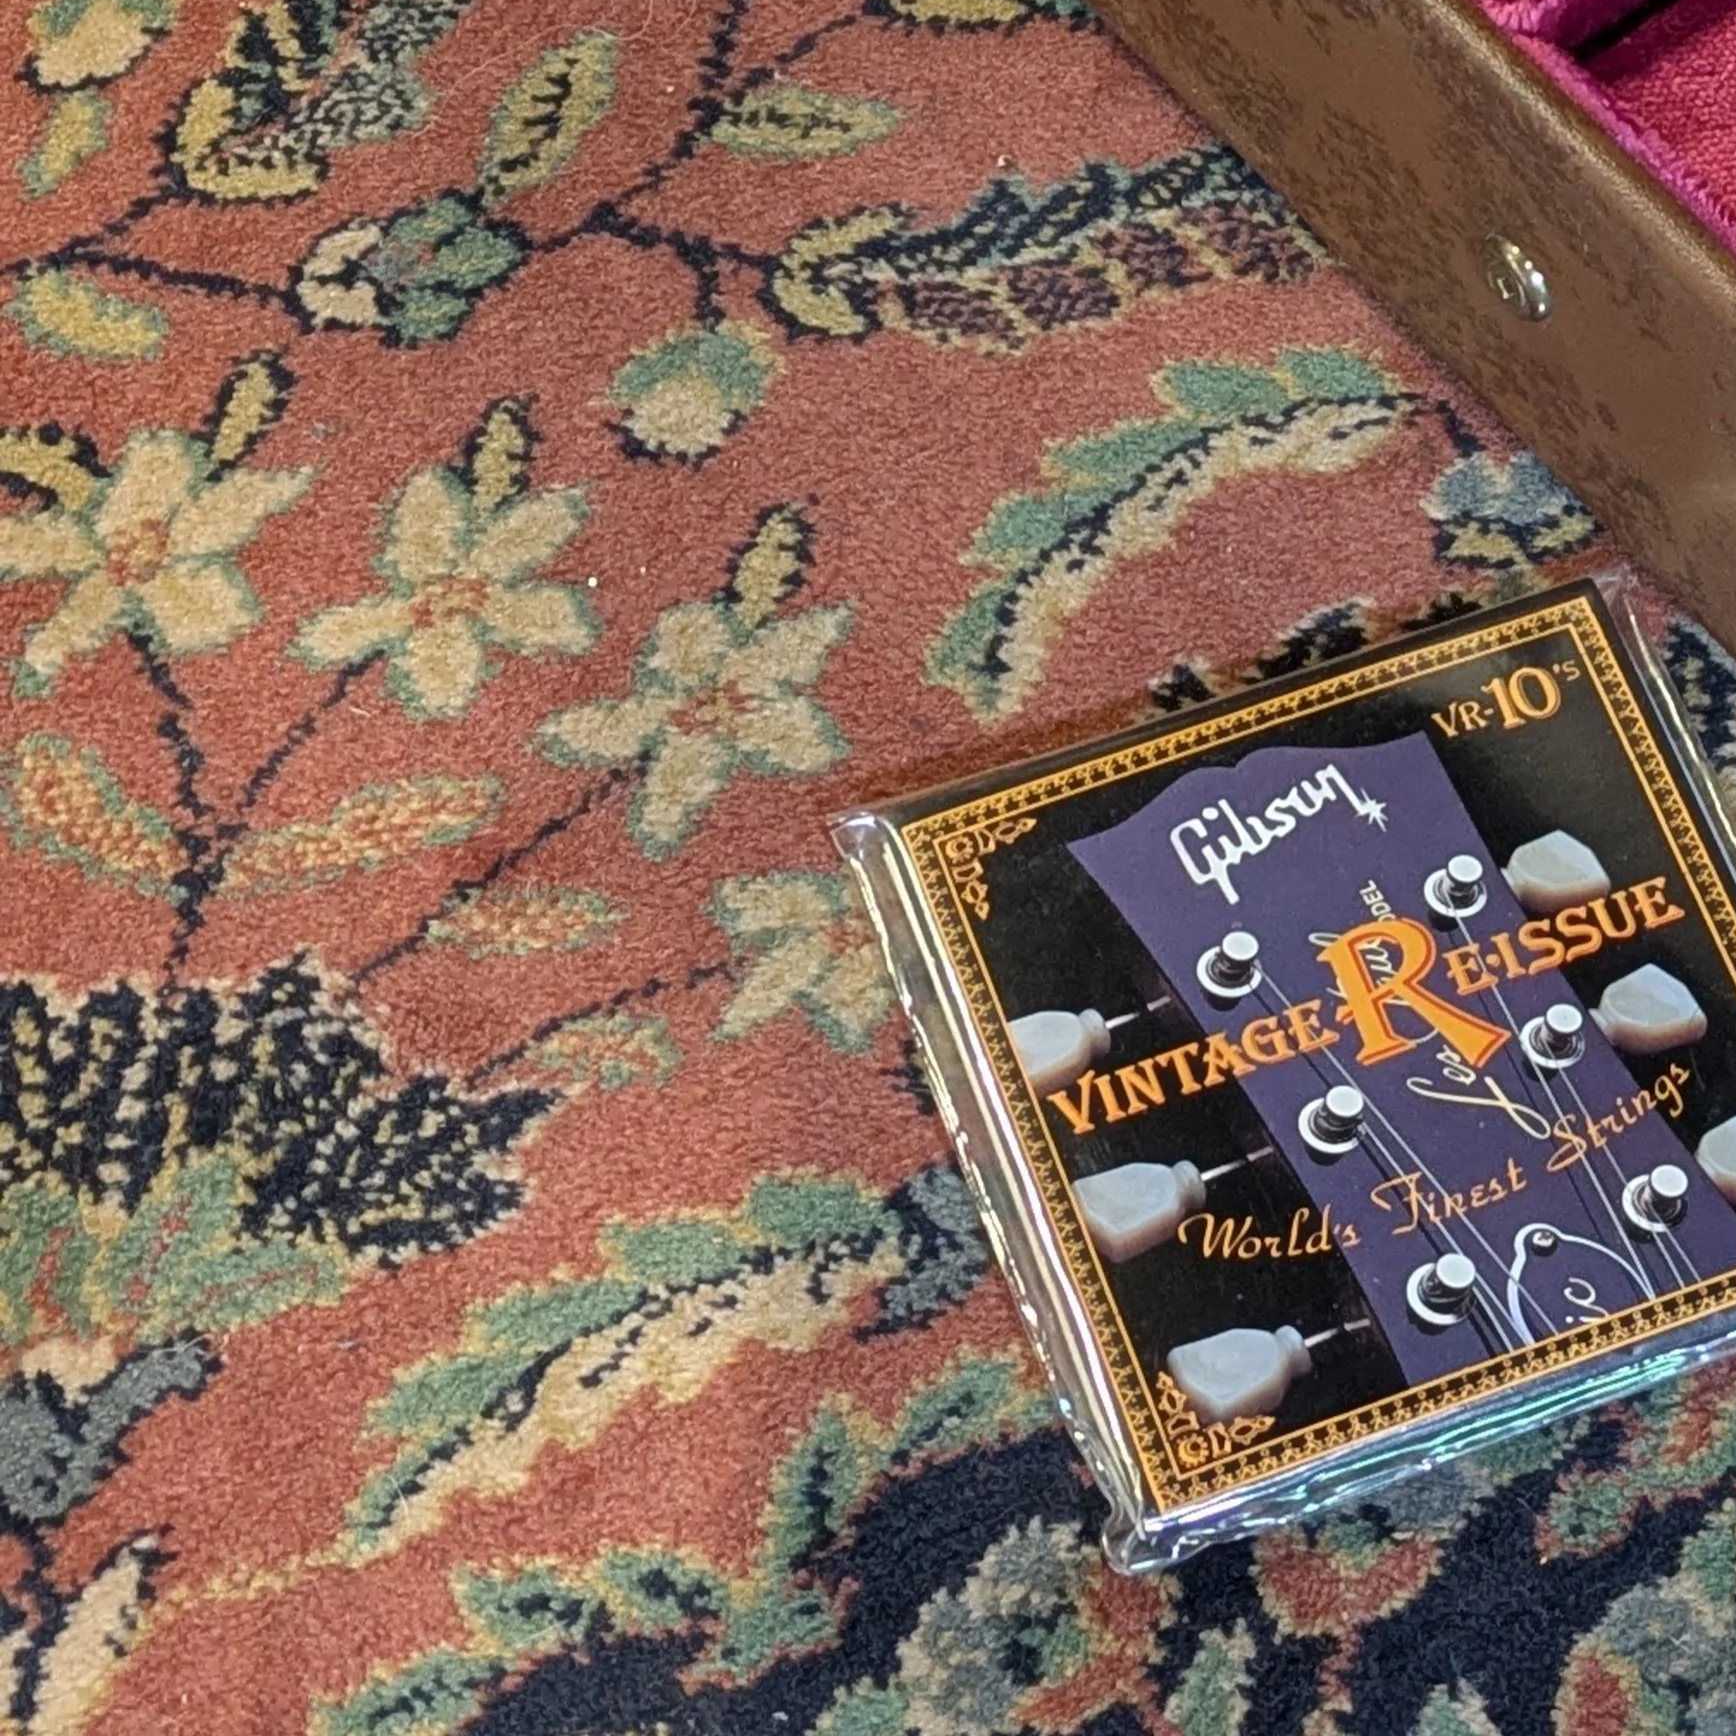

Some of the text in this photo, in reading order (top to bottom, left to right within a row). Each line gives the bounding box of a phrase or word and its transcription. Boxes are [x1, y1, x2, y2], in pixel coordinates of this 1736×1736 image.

[1169, 763, 1382, 905] Gibson
[1047, 999, 1341, 1136] VINTAGE
[1177, 1063, 1691, 1261] World's Finest Strings
